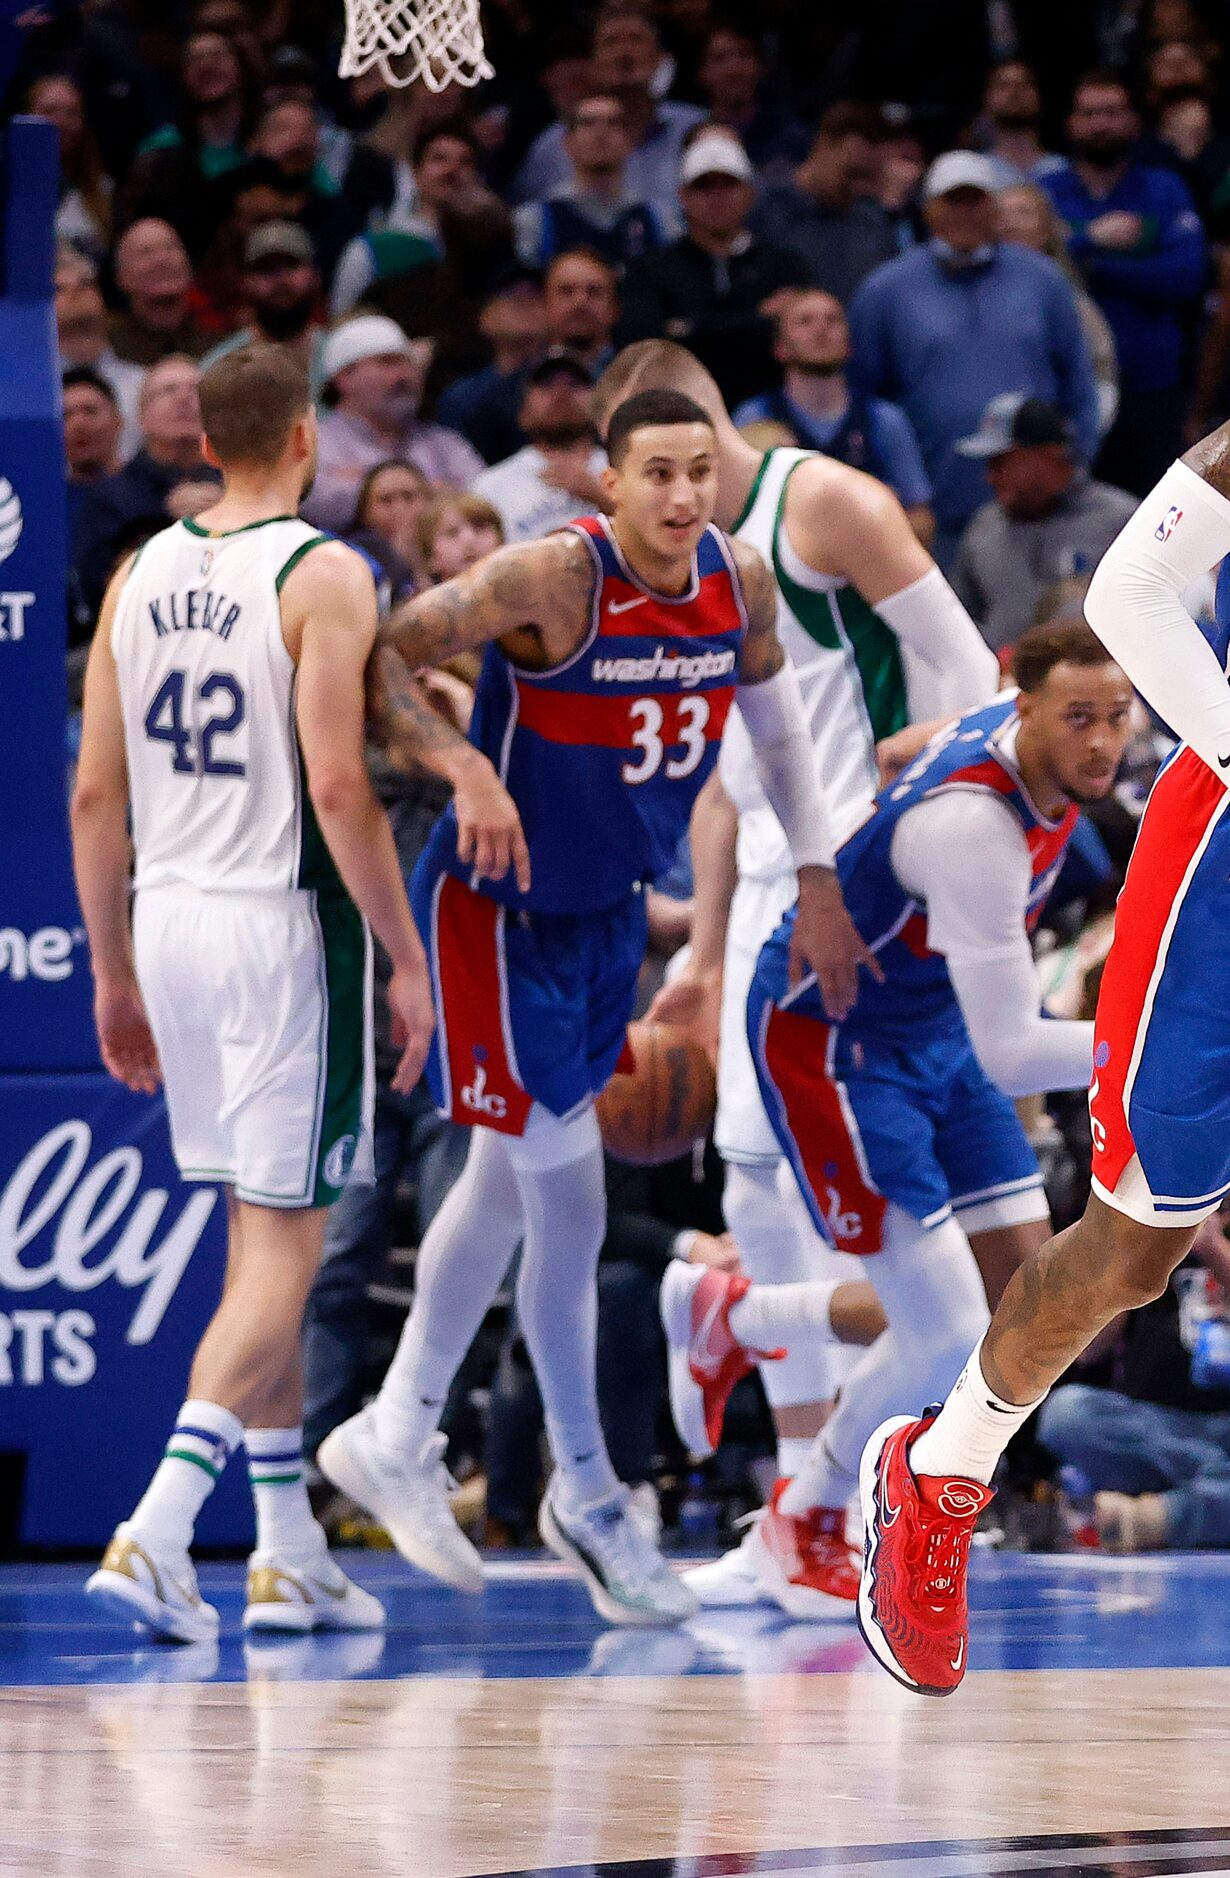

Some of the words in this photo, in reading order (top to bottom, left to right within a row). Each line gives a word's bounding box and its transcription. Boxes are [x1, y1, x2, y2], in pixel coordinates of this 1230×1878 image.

[0, 590, 37, 641] T
[592, 646, 736, 688] washington
[145, 669, 246, 777] 42
[620, 694, 711, 785] 33
